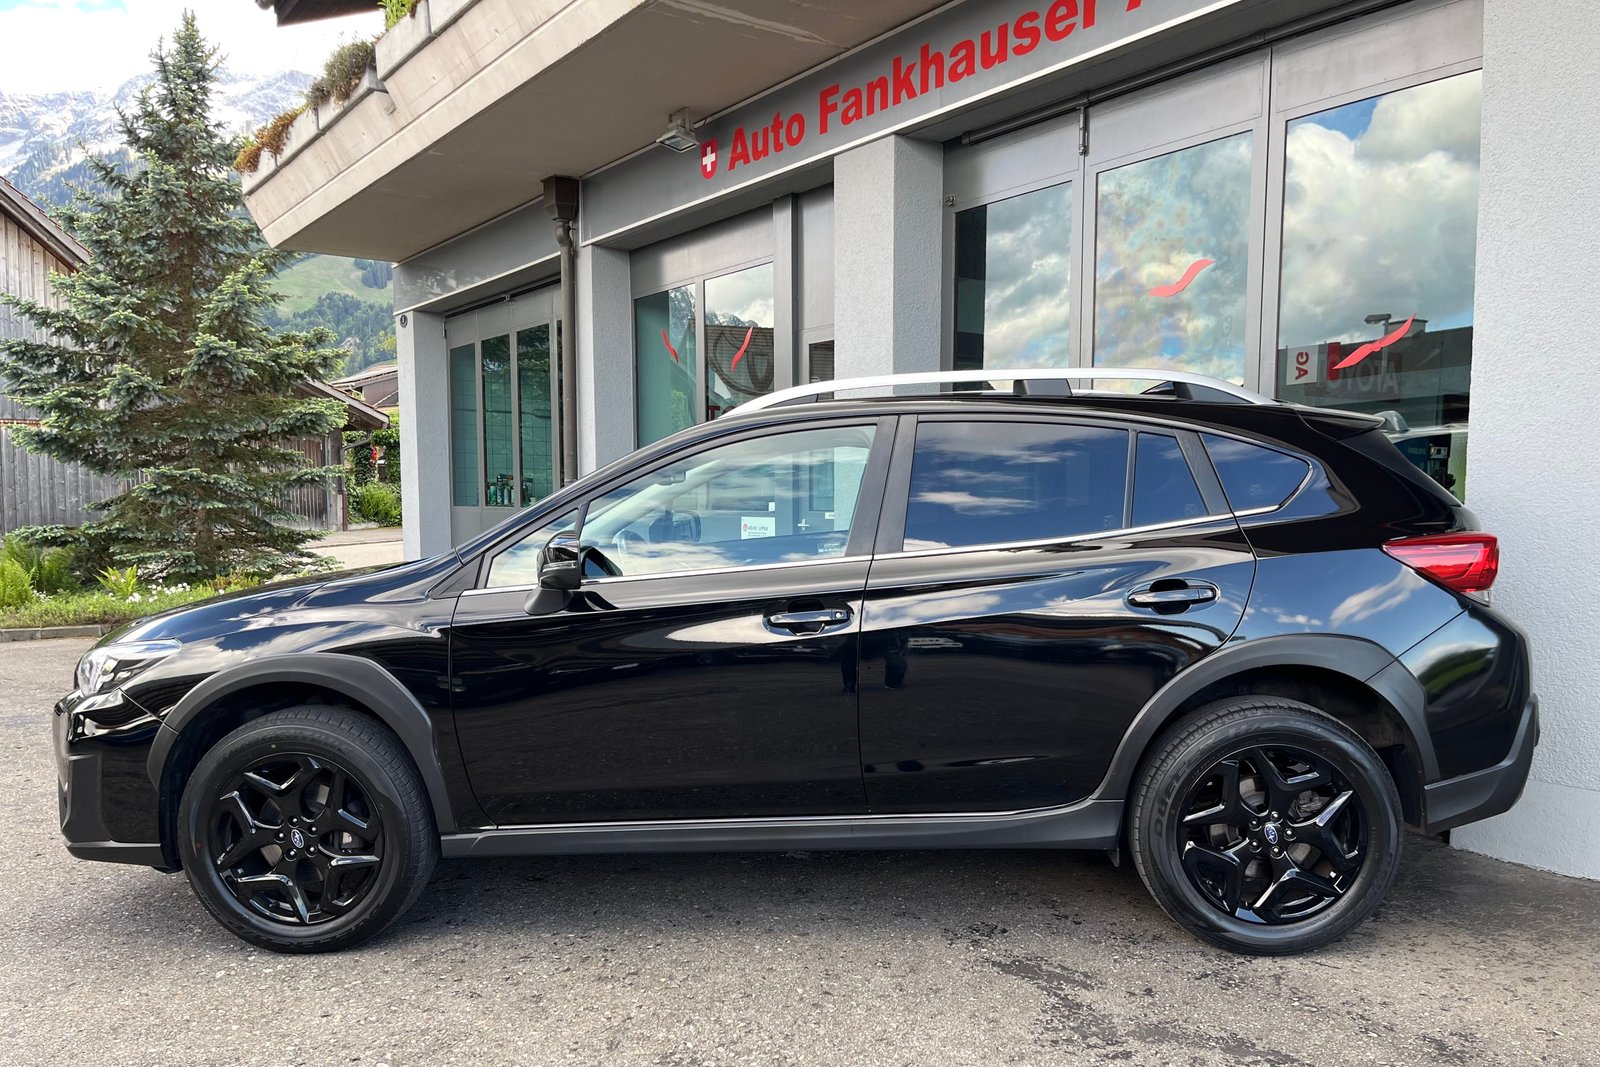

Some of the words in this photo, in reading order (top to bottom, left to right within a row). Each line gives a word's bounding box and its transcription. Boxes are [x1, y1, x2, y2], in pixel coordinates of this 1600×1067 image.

[727, 113, 806, 171] Auto
[819, 0, 1097, 135] Fankhauser
[1323, 355, 1400, 395] OYOTA
